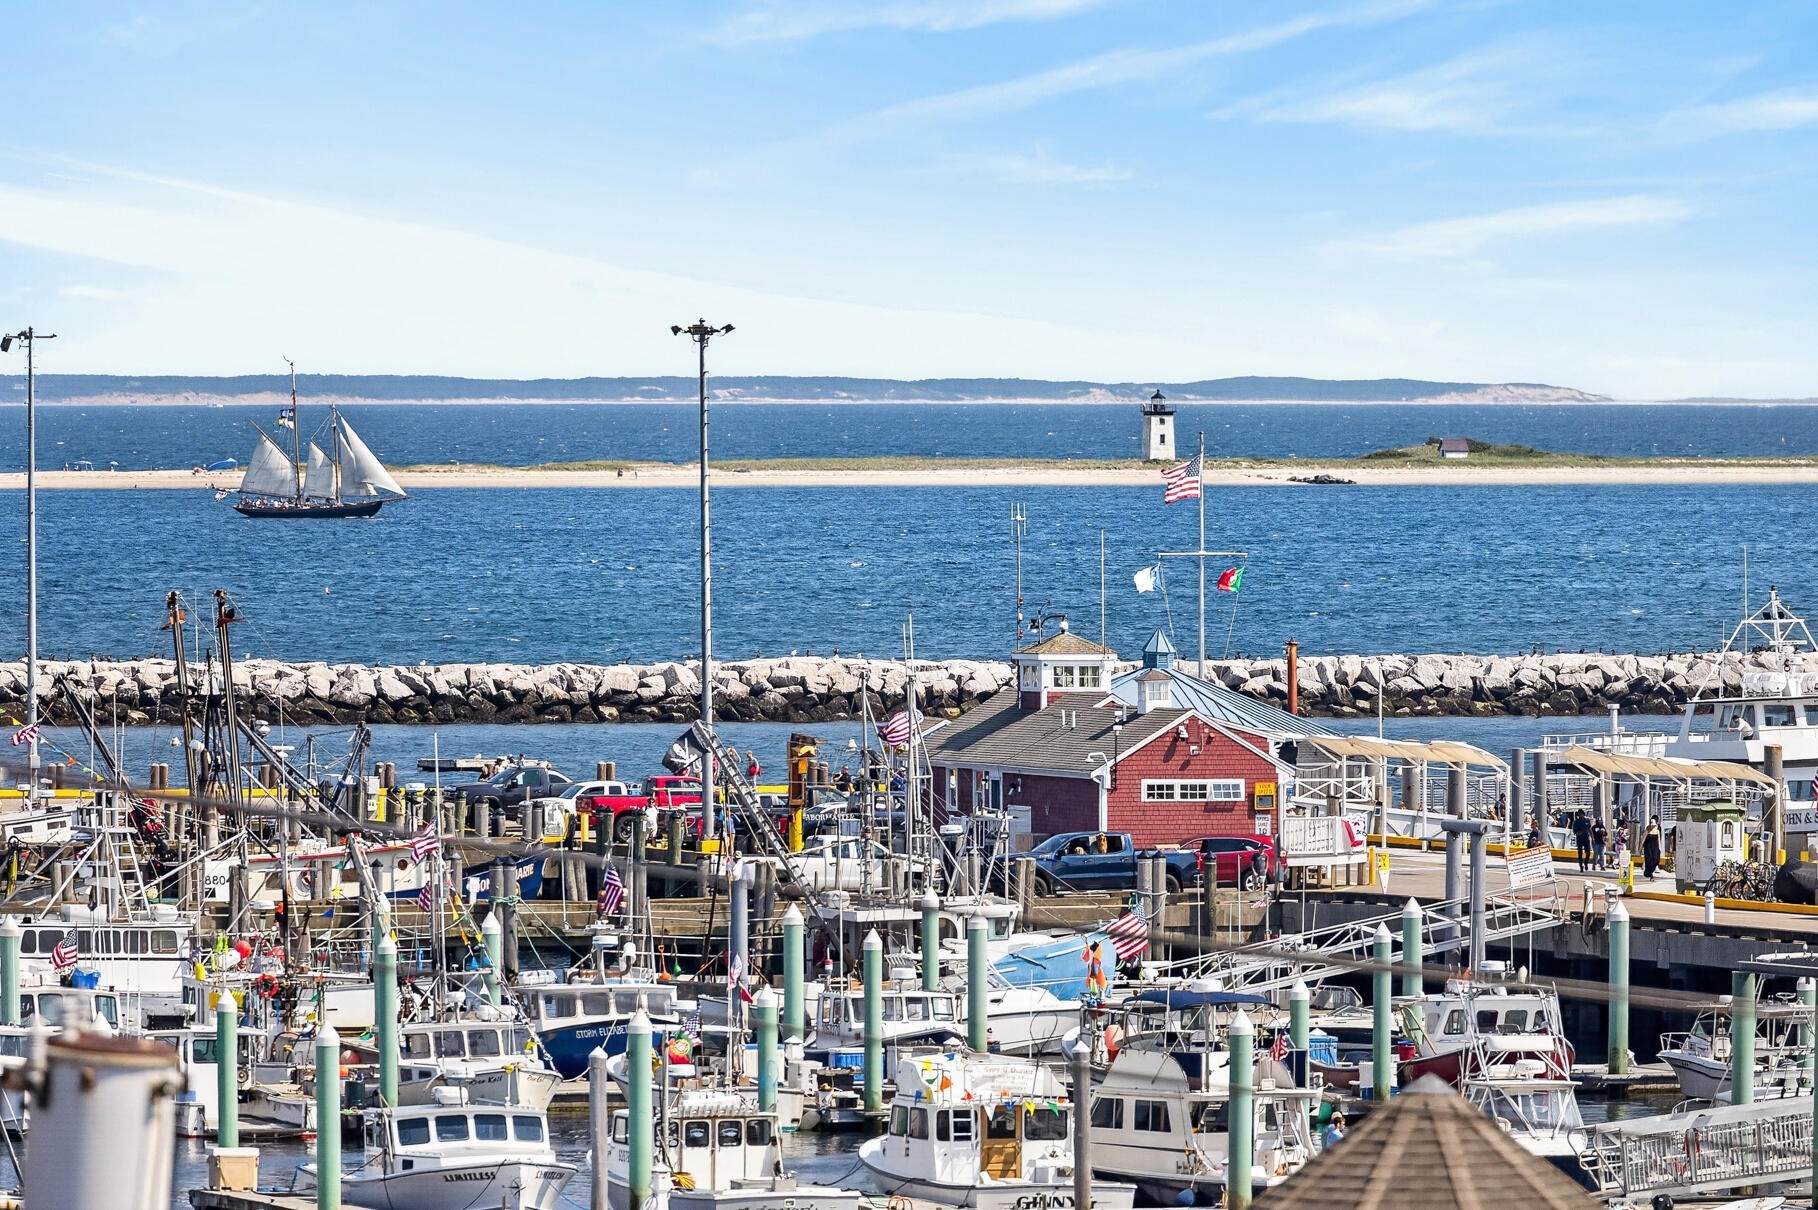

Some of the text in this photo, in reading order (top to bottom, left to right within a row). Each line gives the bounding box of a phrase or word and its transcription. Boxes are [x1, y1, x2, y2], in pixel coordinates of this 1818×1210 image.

[1782, 812, 1802, 825] OHN
[1258, 827, 1268, 835] 10
[515, 863, 535, 880] ARIE
[575, 1024, 628, 1039] STORM ELIZABET
[442, 1170, 496, 1182] LIMITLESS
